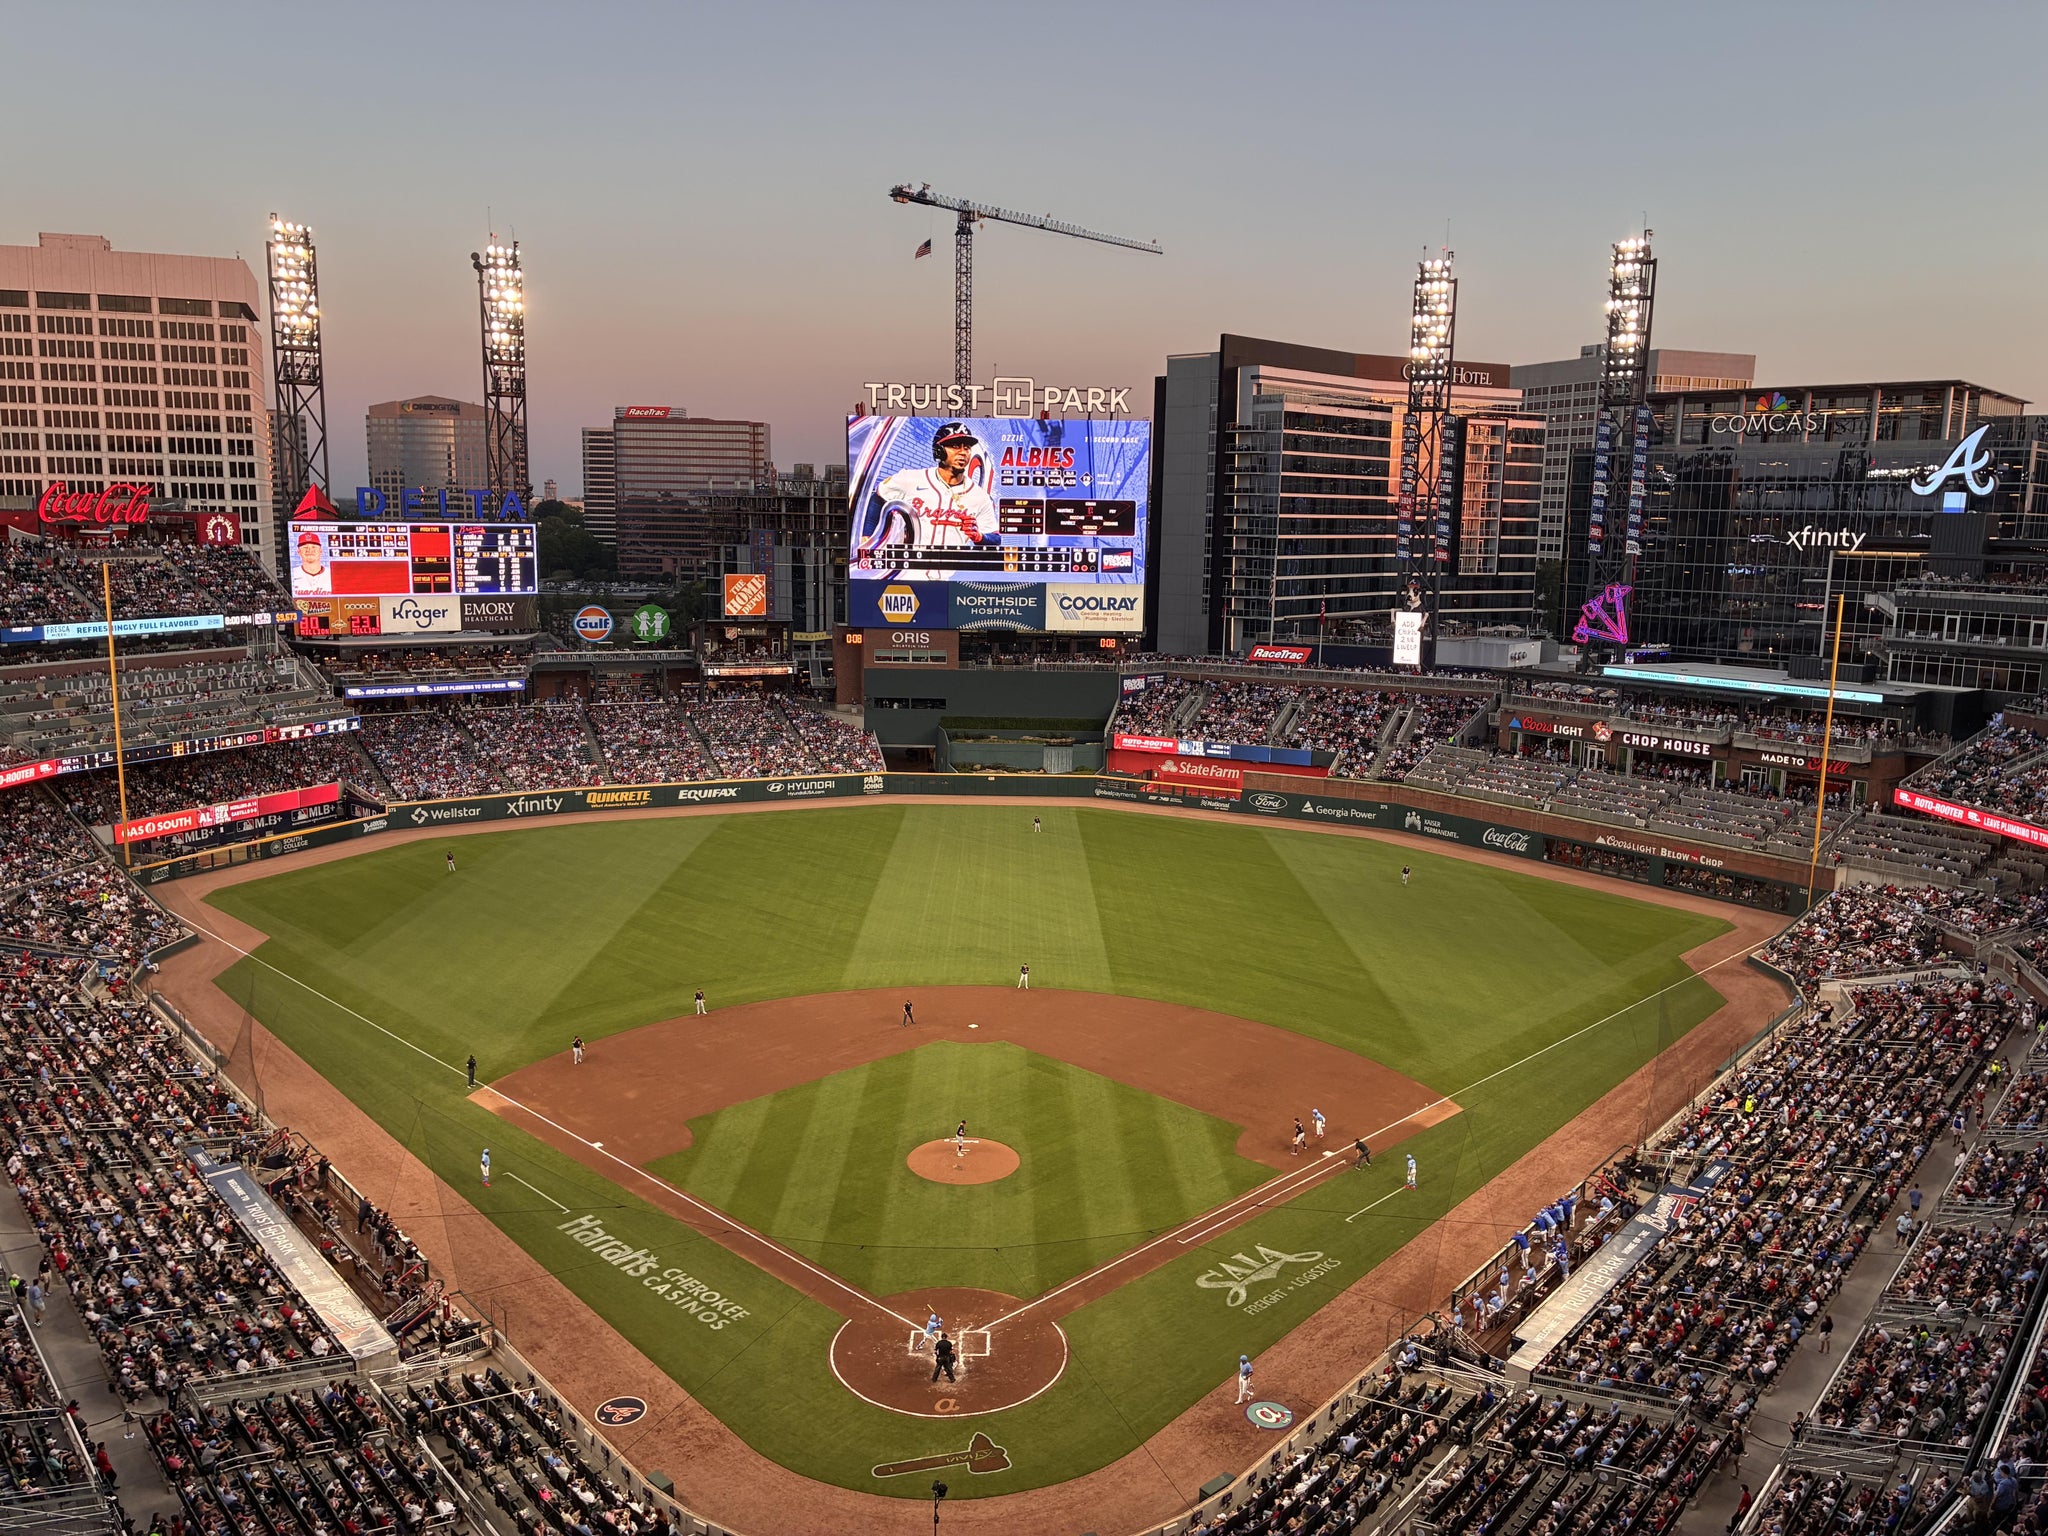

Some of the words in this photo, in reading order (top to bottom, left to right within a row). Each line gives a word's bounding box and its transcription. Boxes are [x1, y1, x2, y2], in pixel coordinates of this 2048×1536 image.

[1453, 367, 1492, 385] HOTEL
[864, 383, 984, 411] TRUIST
[1044, 386, 1132, 413] PARK
[628, 408, 665, 417] RaceTrac
[1711, 412, 1830, 434] COMCAST
[1001, 447, 1075, 468] ALBIES
[39, 482, 154, 523] Coca-Cola
[356, 487, 527, 519] DELTA
[1786, 525, 1866, 552] xfinity
[1074, 553, 1082, 562] 0
[1088, 553, 1096, 562] 0
[726, 575, 765, 614] HOME
[730, 579, 746, 595] THE
[464, 602, 515, 615] EMORY
[742, 589, 765, 614] DEPOT
[884, 597, 914, 612] NAPA
[957, 596, 1037, 607] NORTHSIDE
[1059, 596, 1138, 610] COOLRAY
[241, 615, 252, 624] PM
[393, 599, 448, 629] Kroger
[46, 626, 70, 635] FRESCA
[77, 622, 138, 634] REFRESINGLY
[140, 620, 158, 630] FULL
[160, 619, 199, 629] FLAVORED
[576, 617, 610, 631] Gulf
[847, 634, 862, 643] 0:08
[892, 632, 930, 644] ORIS
[1100, 639, 1116, 648] 0:08
[1254, 648, 1303, 660] RaceTrac
[1522, 716, 1552, 732] Coors
[1554, 724, 1583, 737] LIGHT
[1122, 738, 1173, 748] ROTO-ROOTER
[1623, 733, 1659, 747] CHOP
[1664, 740, 1710, 755] HOUSE
[1761, 753, 1789, 764] MADE
[1792, 757, 1804, 766] TO
[788, 781, 835, 790] HYUNDAI
[586, 791, 651, 803] QUIKRETE
[678, 788, 738, 801] EQUIFAX
[1255, 795, 1280, 807] Ford
[308, 805, 335, 818] MLB+
[507, 796, 563, 815] xfinity
[1316, 806, 1348, 817] Georgia
[1351, 808, 1376, 820] Power
[199, 812, 212, 824] AL
[431, 807, 481, 820] Wellstar
[1914, 798, 1964, 819] ROTO-ROOTER
[1984, 816, 2000, 829] LEAVE
[2001, 821, 2030, 838] PLUMBING
[2030, 830, 2038, 840] TO
[157, 816, 192, 831] SOUTH
[1424, 819, 1441, 828] KAISER
[185, 828, 214, 843] MLB+
[1483, 828, 1531, 852] Coca-Cola
[283, 839, 308, 850] COLLEGE
[1607, 835, 1632, 849] Coors
[1632, 841, 1656, 855] LIGHT
[1661, 848, 1689, 861] BELOW
[1700, 855, 1723, 867] CHOP
[245, 1202, 274, 1228] TRUIST
[272, 1232, 296, 1256] PARK
[1195, 1243, 1324, 1307] SAIA
[1243, 1288, 1287, 1315] FREIGHT
[1293, 1258, 1341, 1287] LOGISTICS
[662, 1268, 751, 1321] CHEROKEE
[1535, 1319, 1557, 1343] WELCOME
[1562, 1282, 1598, 1312] TRUIST
[1599, 1254, 1626, 1280] PARK
[643, 1276, 730, 1330] CASINOS
